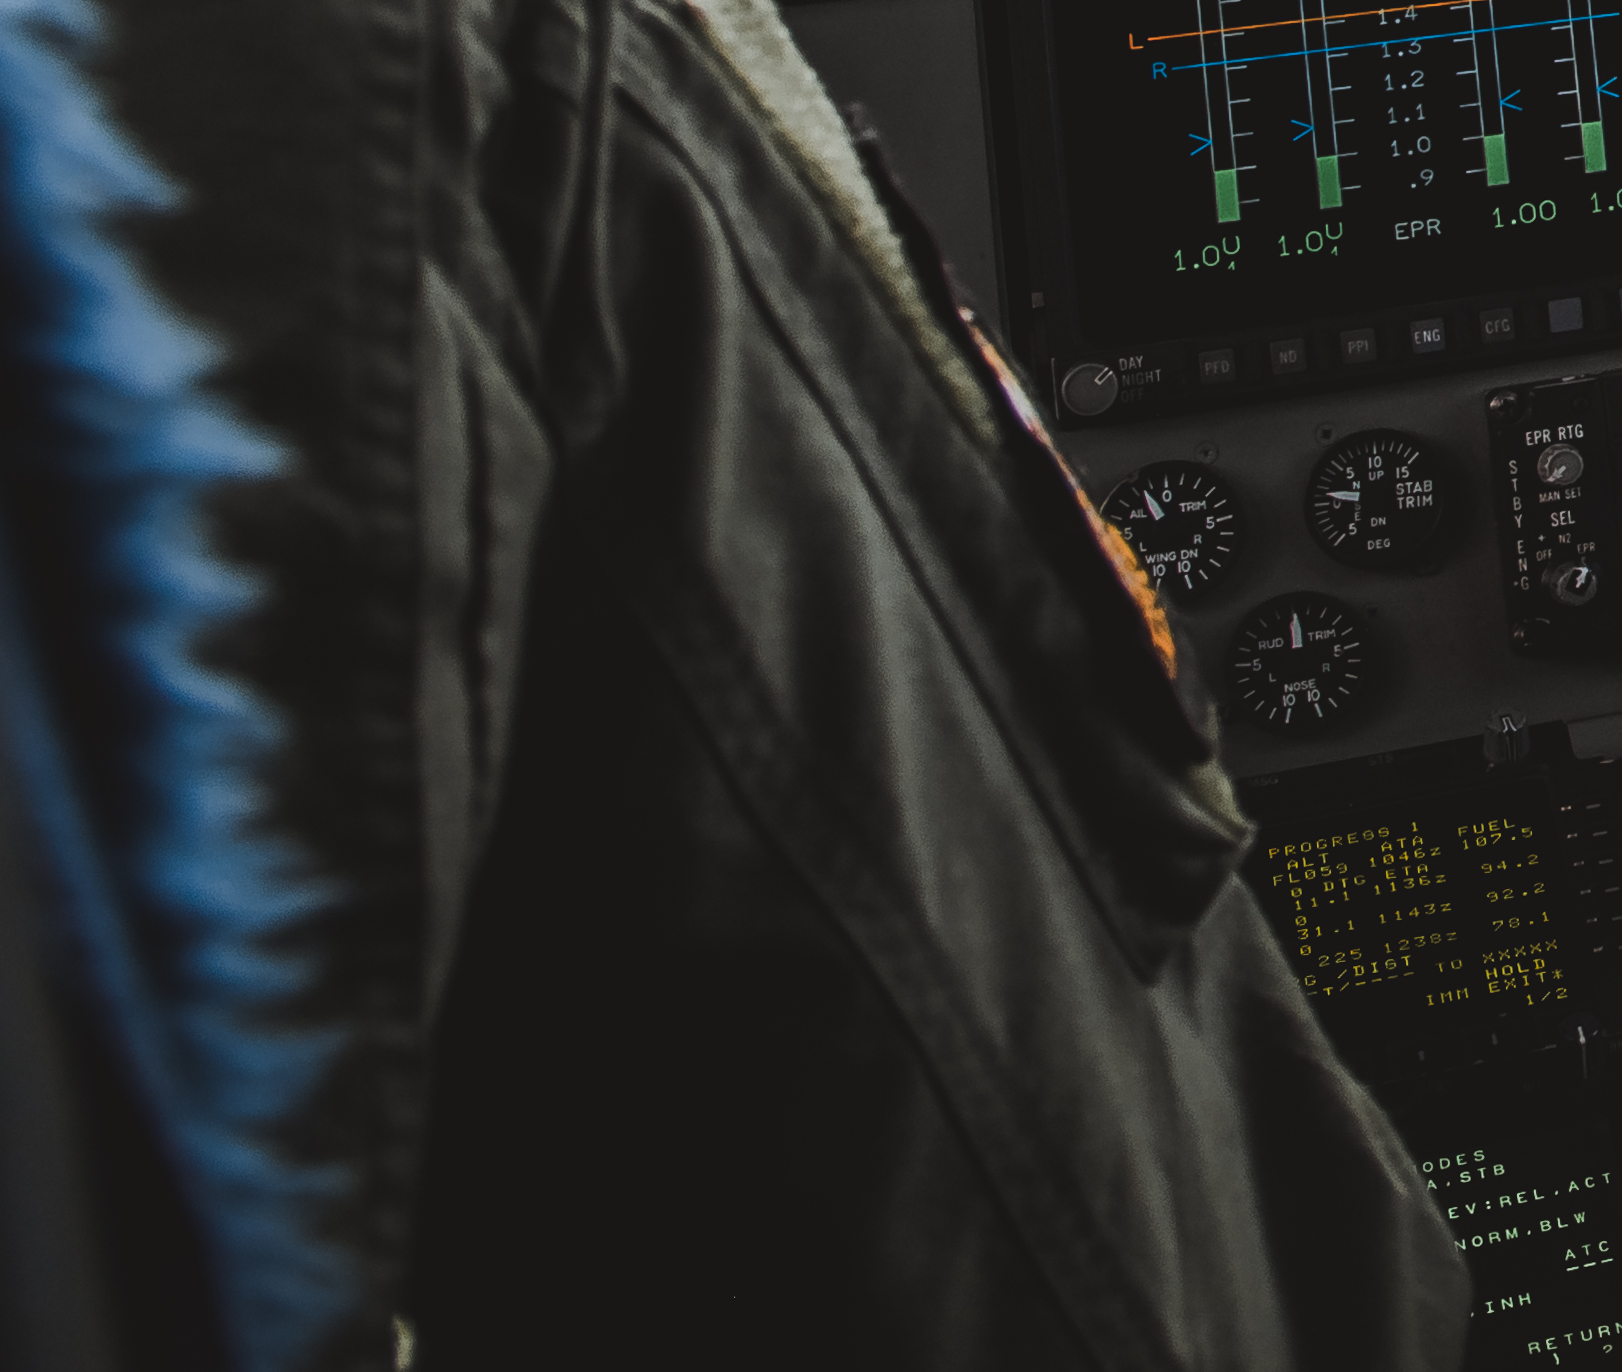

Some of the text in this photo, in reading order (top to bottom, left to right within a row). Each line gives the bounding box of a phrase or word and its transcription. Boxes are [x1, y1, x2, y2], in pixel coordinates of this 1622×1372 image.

[1383, 70, 1426, 92] 1.2
[1386, 104, 1427, 125] 1.1
[1389, 135, 1432, 157] 1.0
[1394, 218, 1442, 242] EPR
[1412, 327, 1441, 346] ENG
[1525, 422, 1585, 446] EPR RTG
[1396, 478, 1433, 495] STAB
[1397, 492, 1433, 509] TRIM
[1550, 510, 1576, 528] SEL
[1144, 547, 1199, 564] WING DN
[1269, 818, 1516, 859] PROGRESS 1 FUEL
[1463, 827, 1533, 850] 107.5
[1485, 958, 1546, 980] HOLD
[1565, 1241, 1610, 1261] ATC
